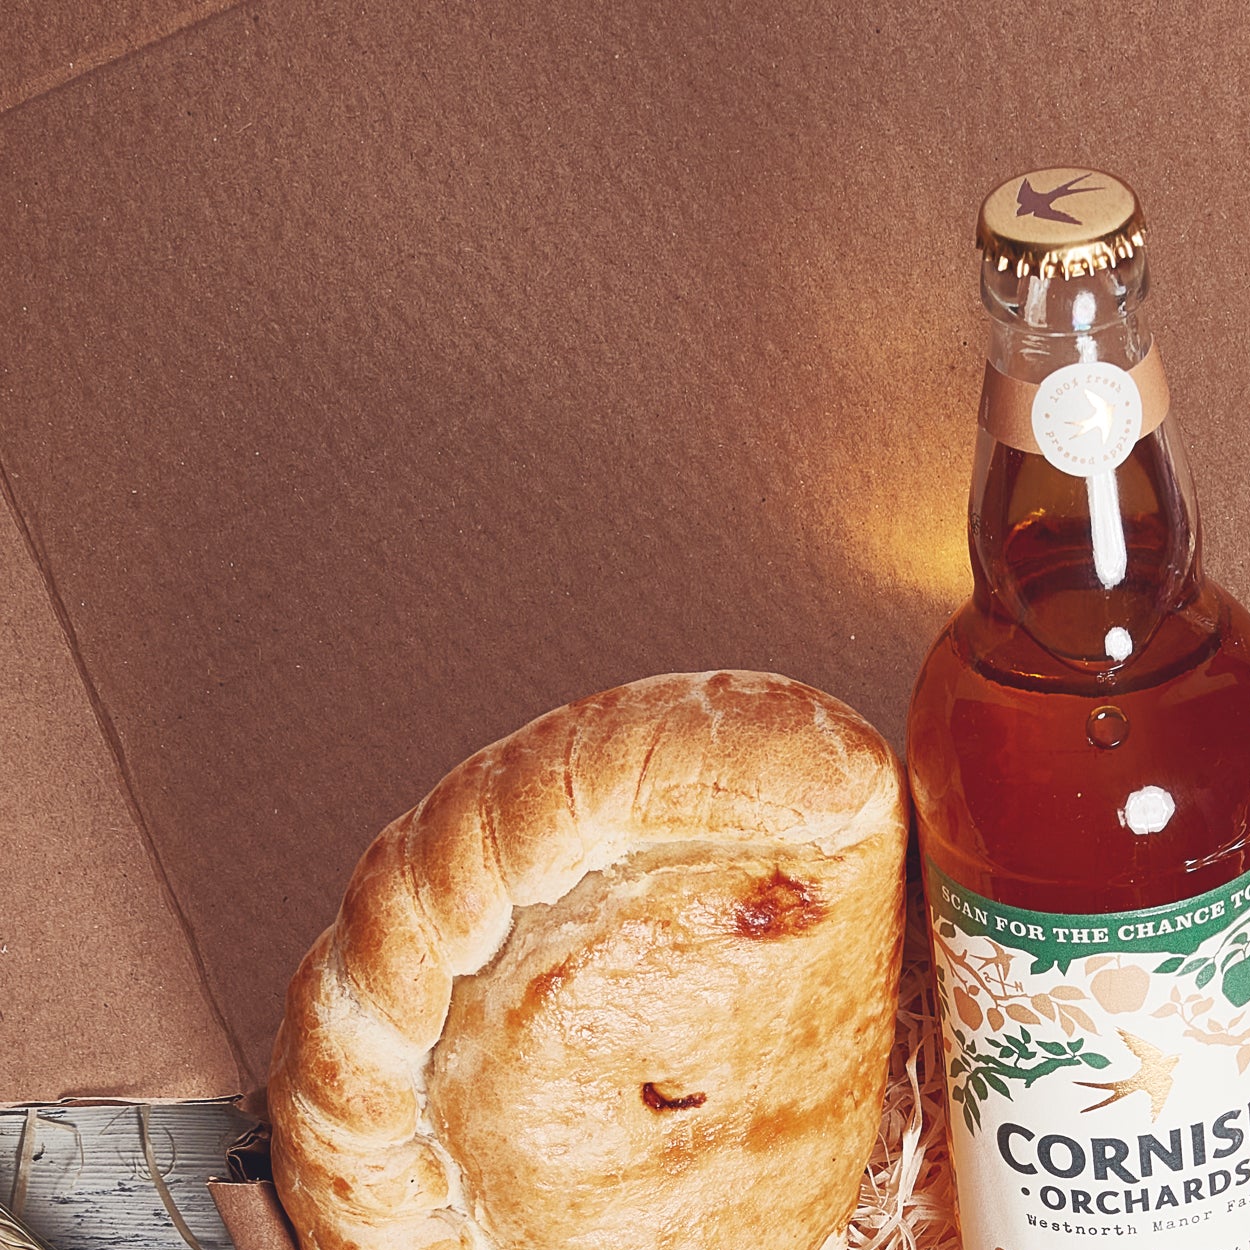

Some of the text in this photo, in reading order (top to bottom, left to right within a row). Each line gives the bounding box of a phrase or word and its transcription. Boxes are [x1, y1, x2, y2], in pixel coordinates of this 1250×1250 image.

[1085, 374, 1122, 393] fresh
[1045, 418, 1133, 465] pressed apples
[941, 885, 989, 926] SCAN
[995, 916, 1046, 941] FOR
[1053, 927, 1109, 944] THE
[1117, 900, 1226, 940] CHANCE
[1026, 1213, 1138, 1236] Westnorth
[1153, 1209, 1213, 1233] Manor
